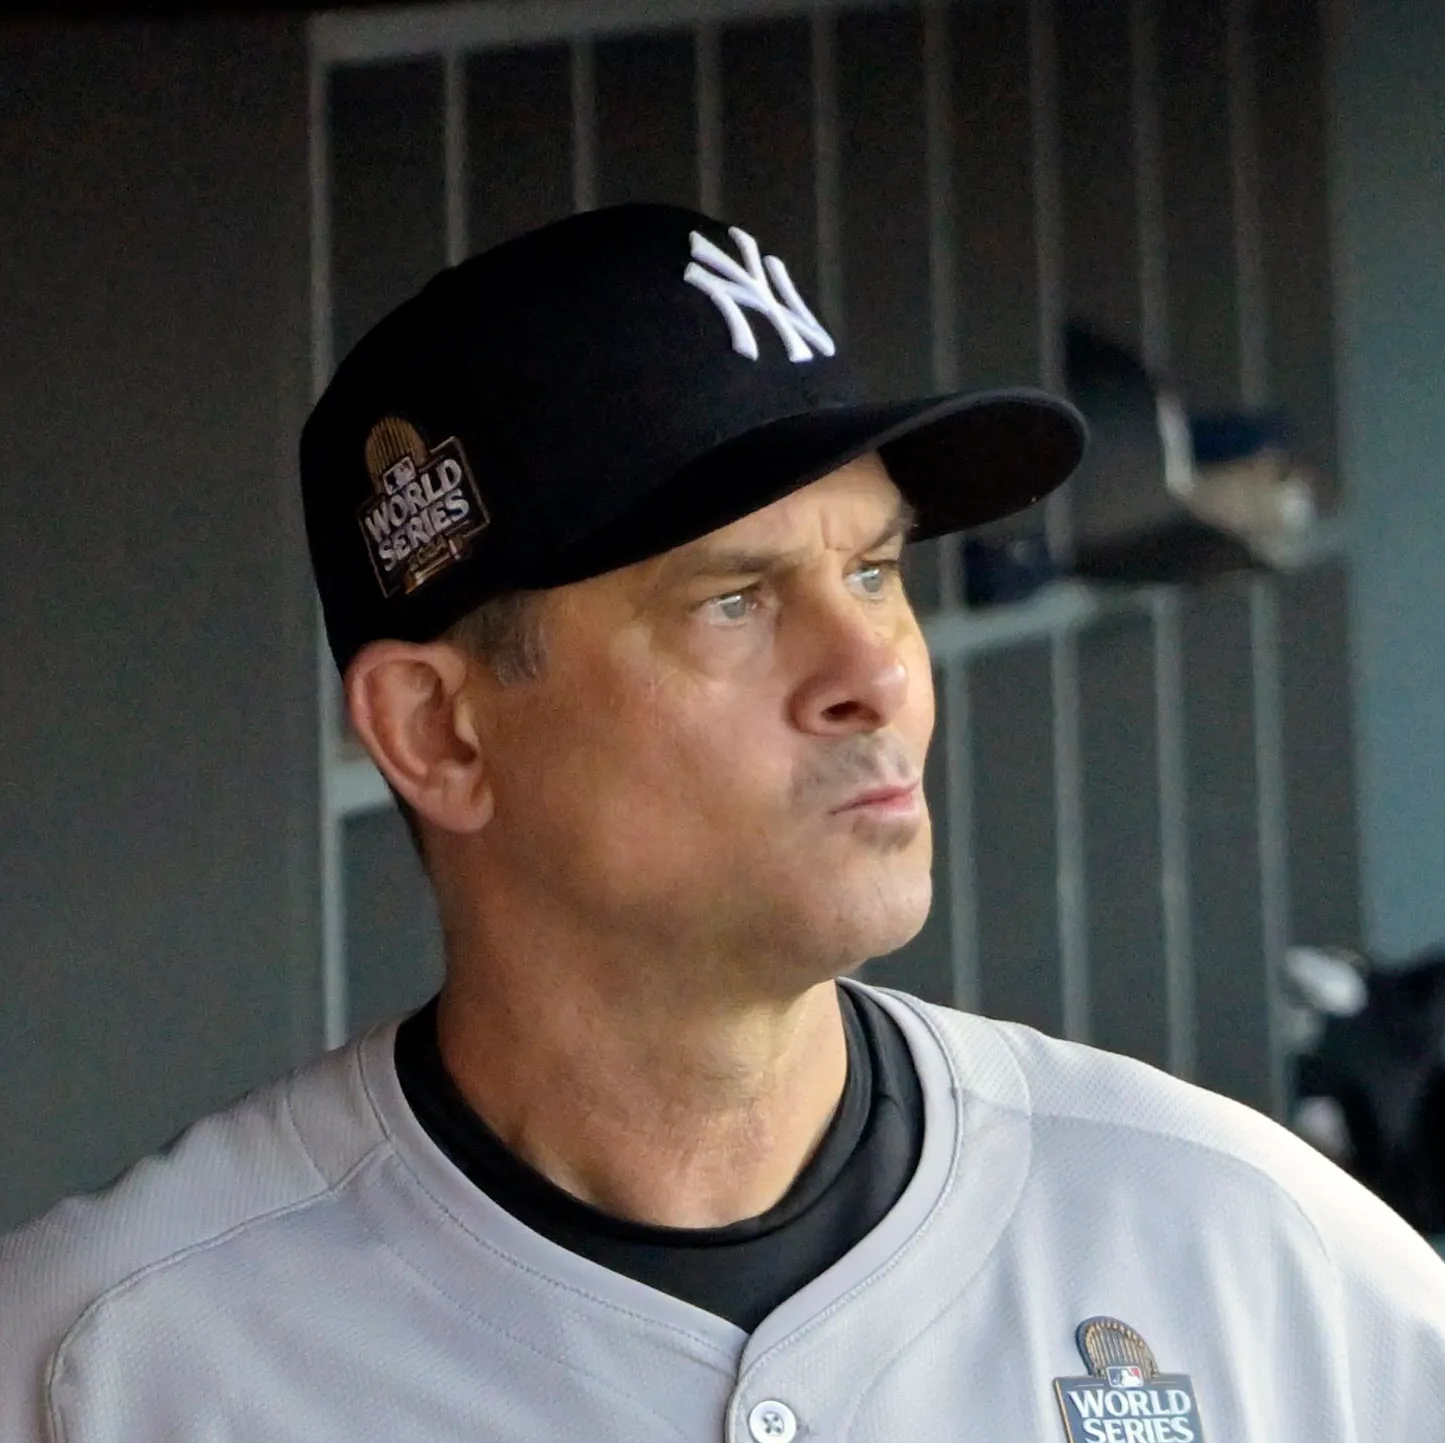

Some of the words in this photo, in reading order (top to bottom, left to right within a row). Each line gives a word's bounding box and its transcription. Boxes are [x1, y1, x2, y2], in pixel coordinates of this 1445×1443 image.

[683, 226, 836, 363] NY
[364, 457, 462, 544] WORLD
[377, 488, 470, 572] SERIES
[1067, 1389, 1192, 1418] WORLD
